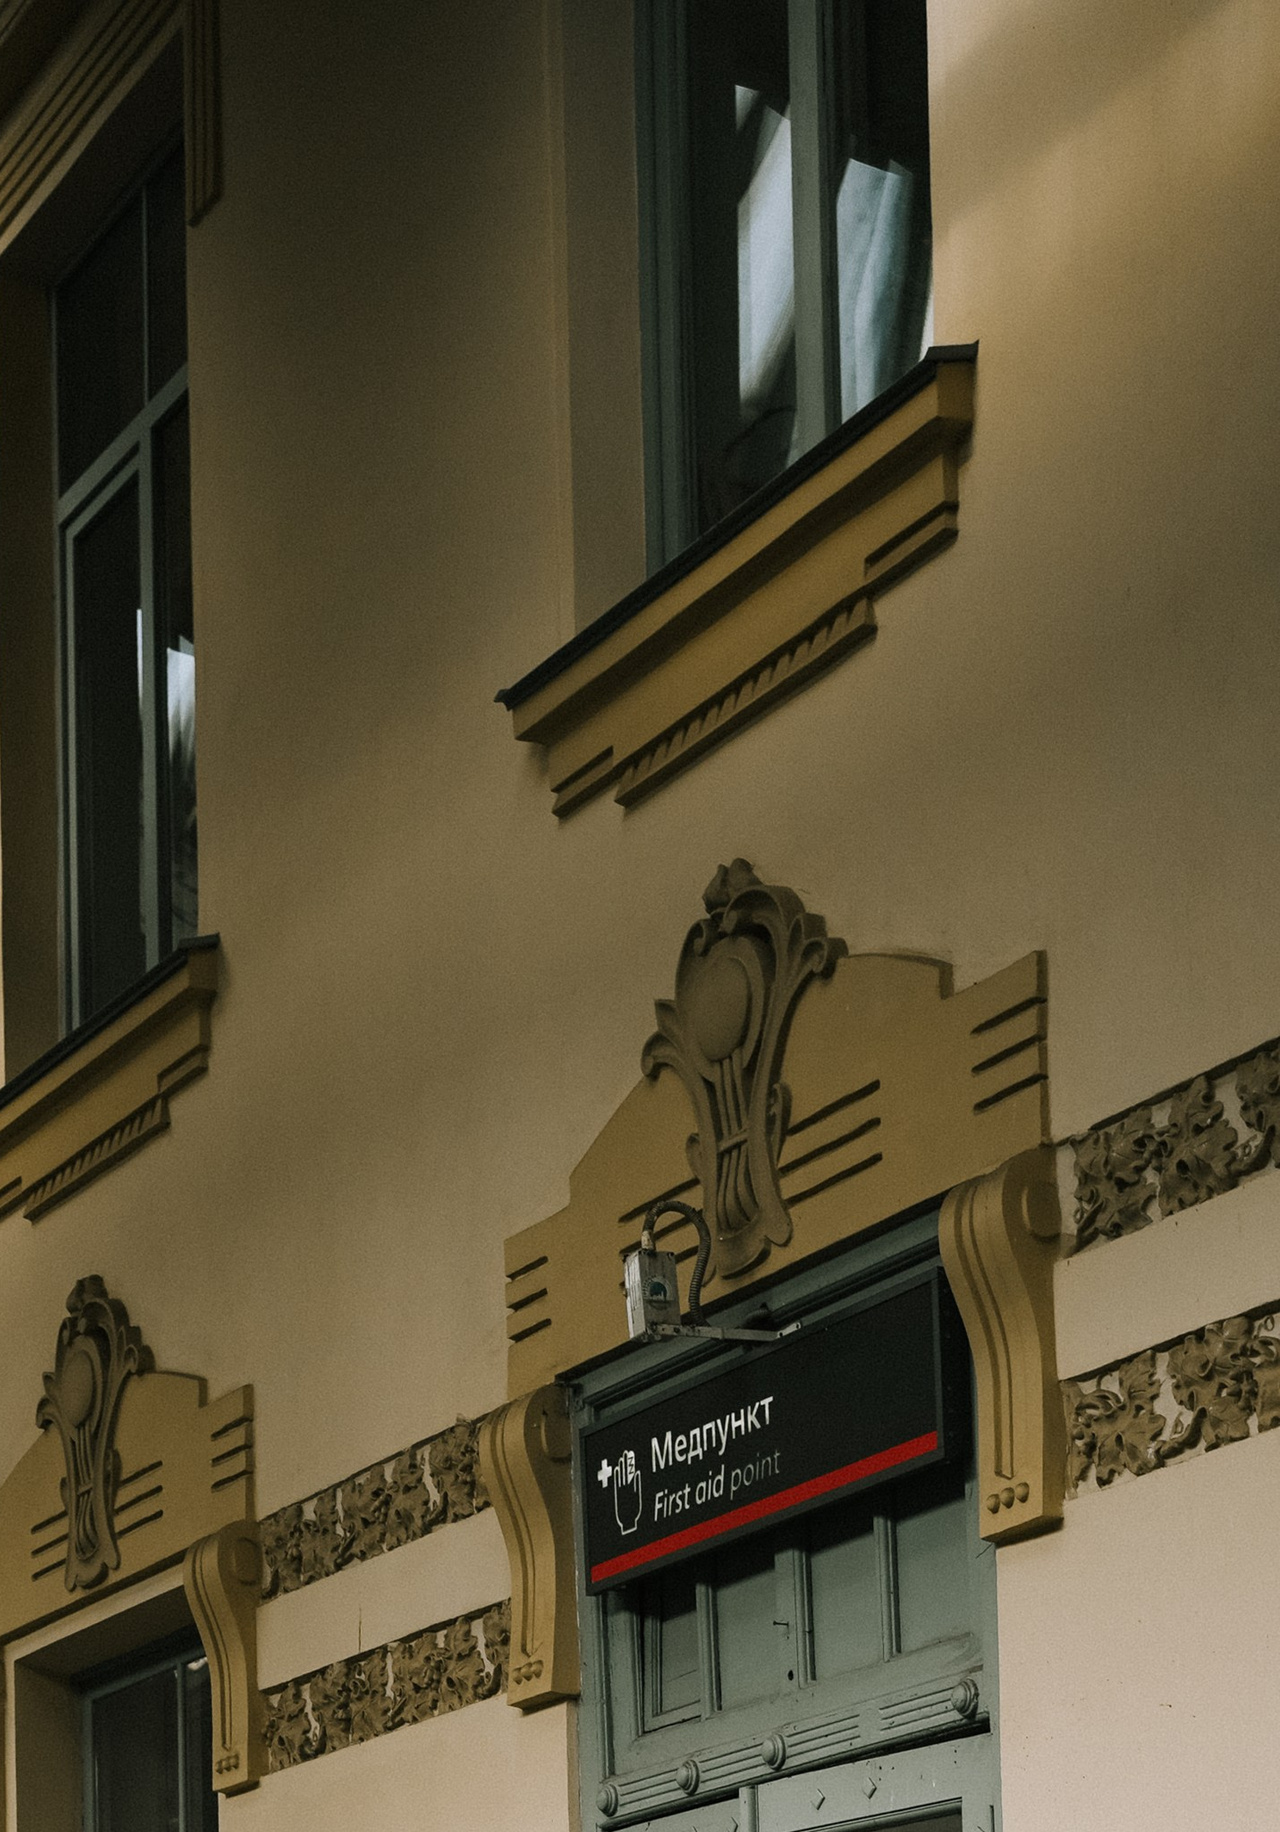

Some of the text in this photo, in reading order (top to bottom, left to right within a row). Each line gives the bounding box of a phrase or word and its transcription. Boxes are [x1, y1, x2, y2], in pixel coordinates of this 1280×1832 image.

[651, 1396, 774, 1473] Медпункт
[654, 1448, 781, 1521] First aid point
